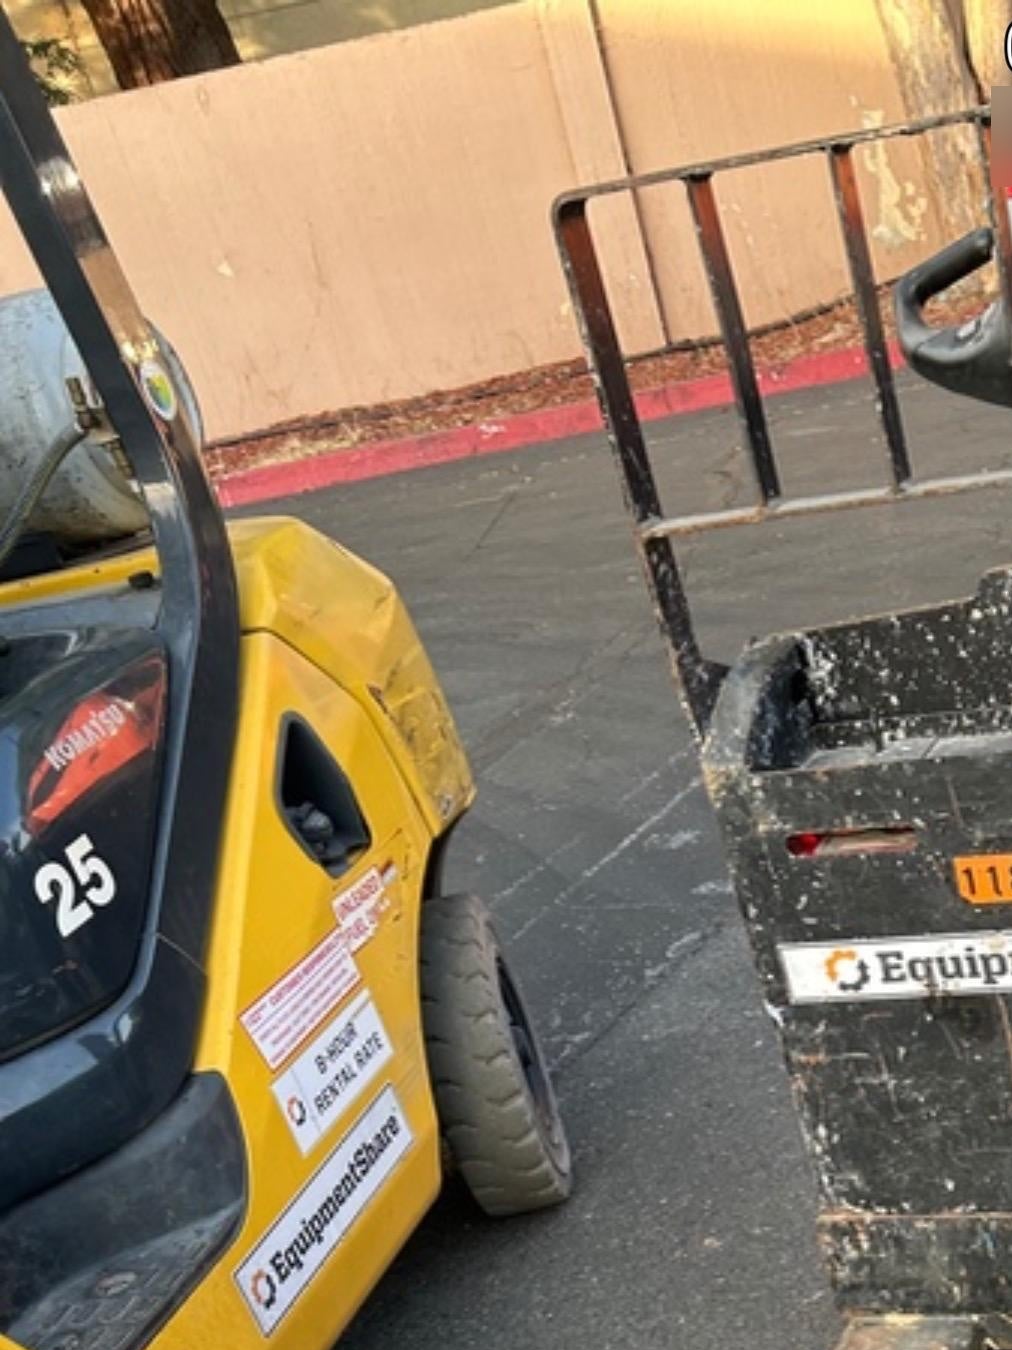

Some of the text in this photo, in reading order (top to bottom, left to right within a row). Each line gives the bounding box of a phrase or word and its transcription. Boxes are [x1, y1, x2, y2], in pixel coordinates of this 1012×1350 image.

[44, 704, 126, 771] KOMATSU
[34, 833, 117, 937] 25
[314, 1065, 357, 1116] RENTAL
[353, 1031, 384, 1070] RATE
[269, 1115, 400, 1284] EquipmentShare
